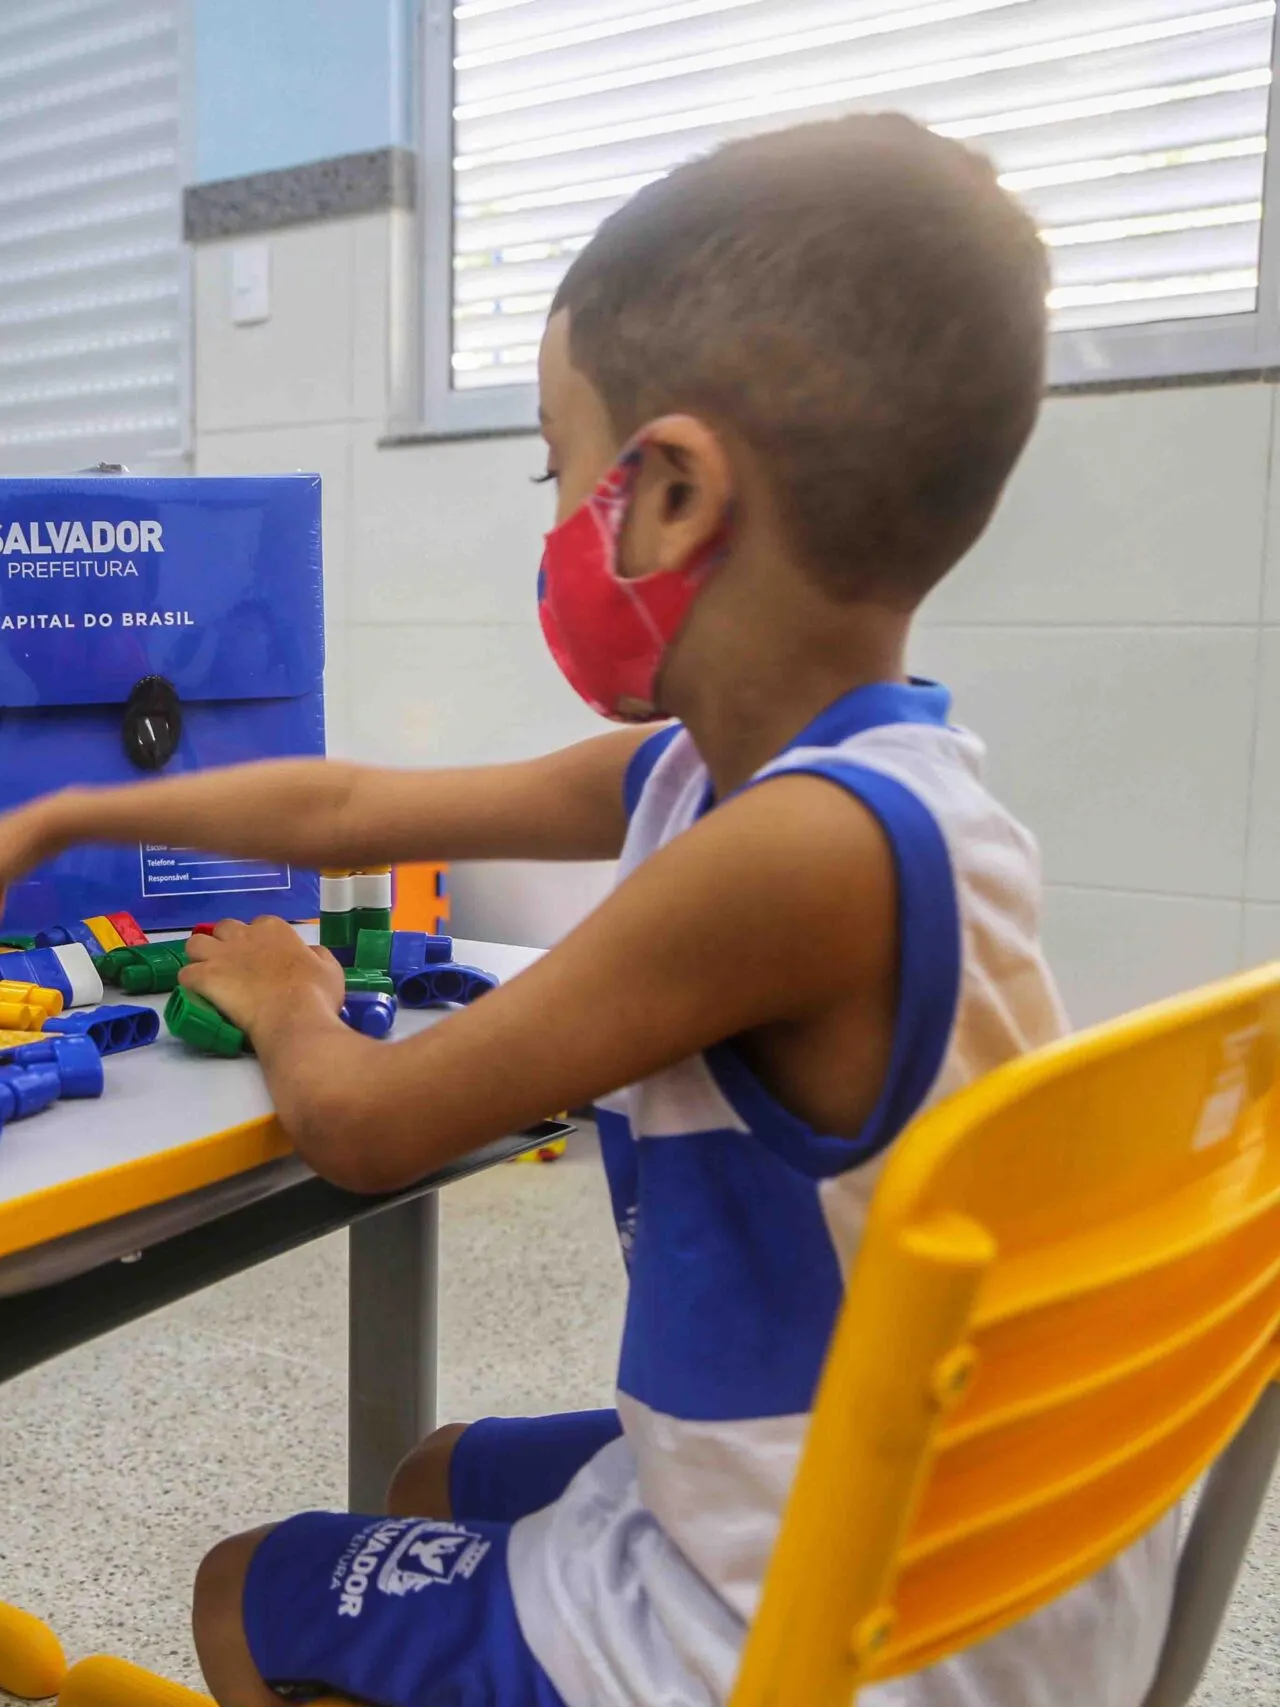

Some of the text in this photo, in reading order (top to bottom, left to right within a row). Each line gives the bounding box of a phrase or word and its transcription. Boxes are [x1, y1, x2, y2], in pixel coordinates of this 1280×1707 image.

[8, 560, 138, 578] PREFEITURA
[84, 612, 113, 628] DO
[122, 610, 195, 627] BRASIL
[147, 859, 175, 867] Telefone
[148, 873, 189, 883] Responsável
